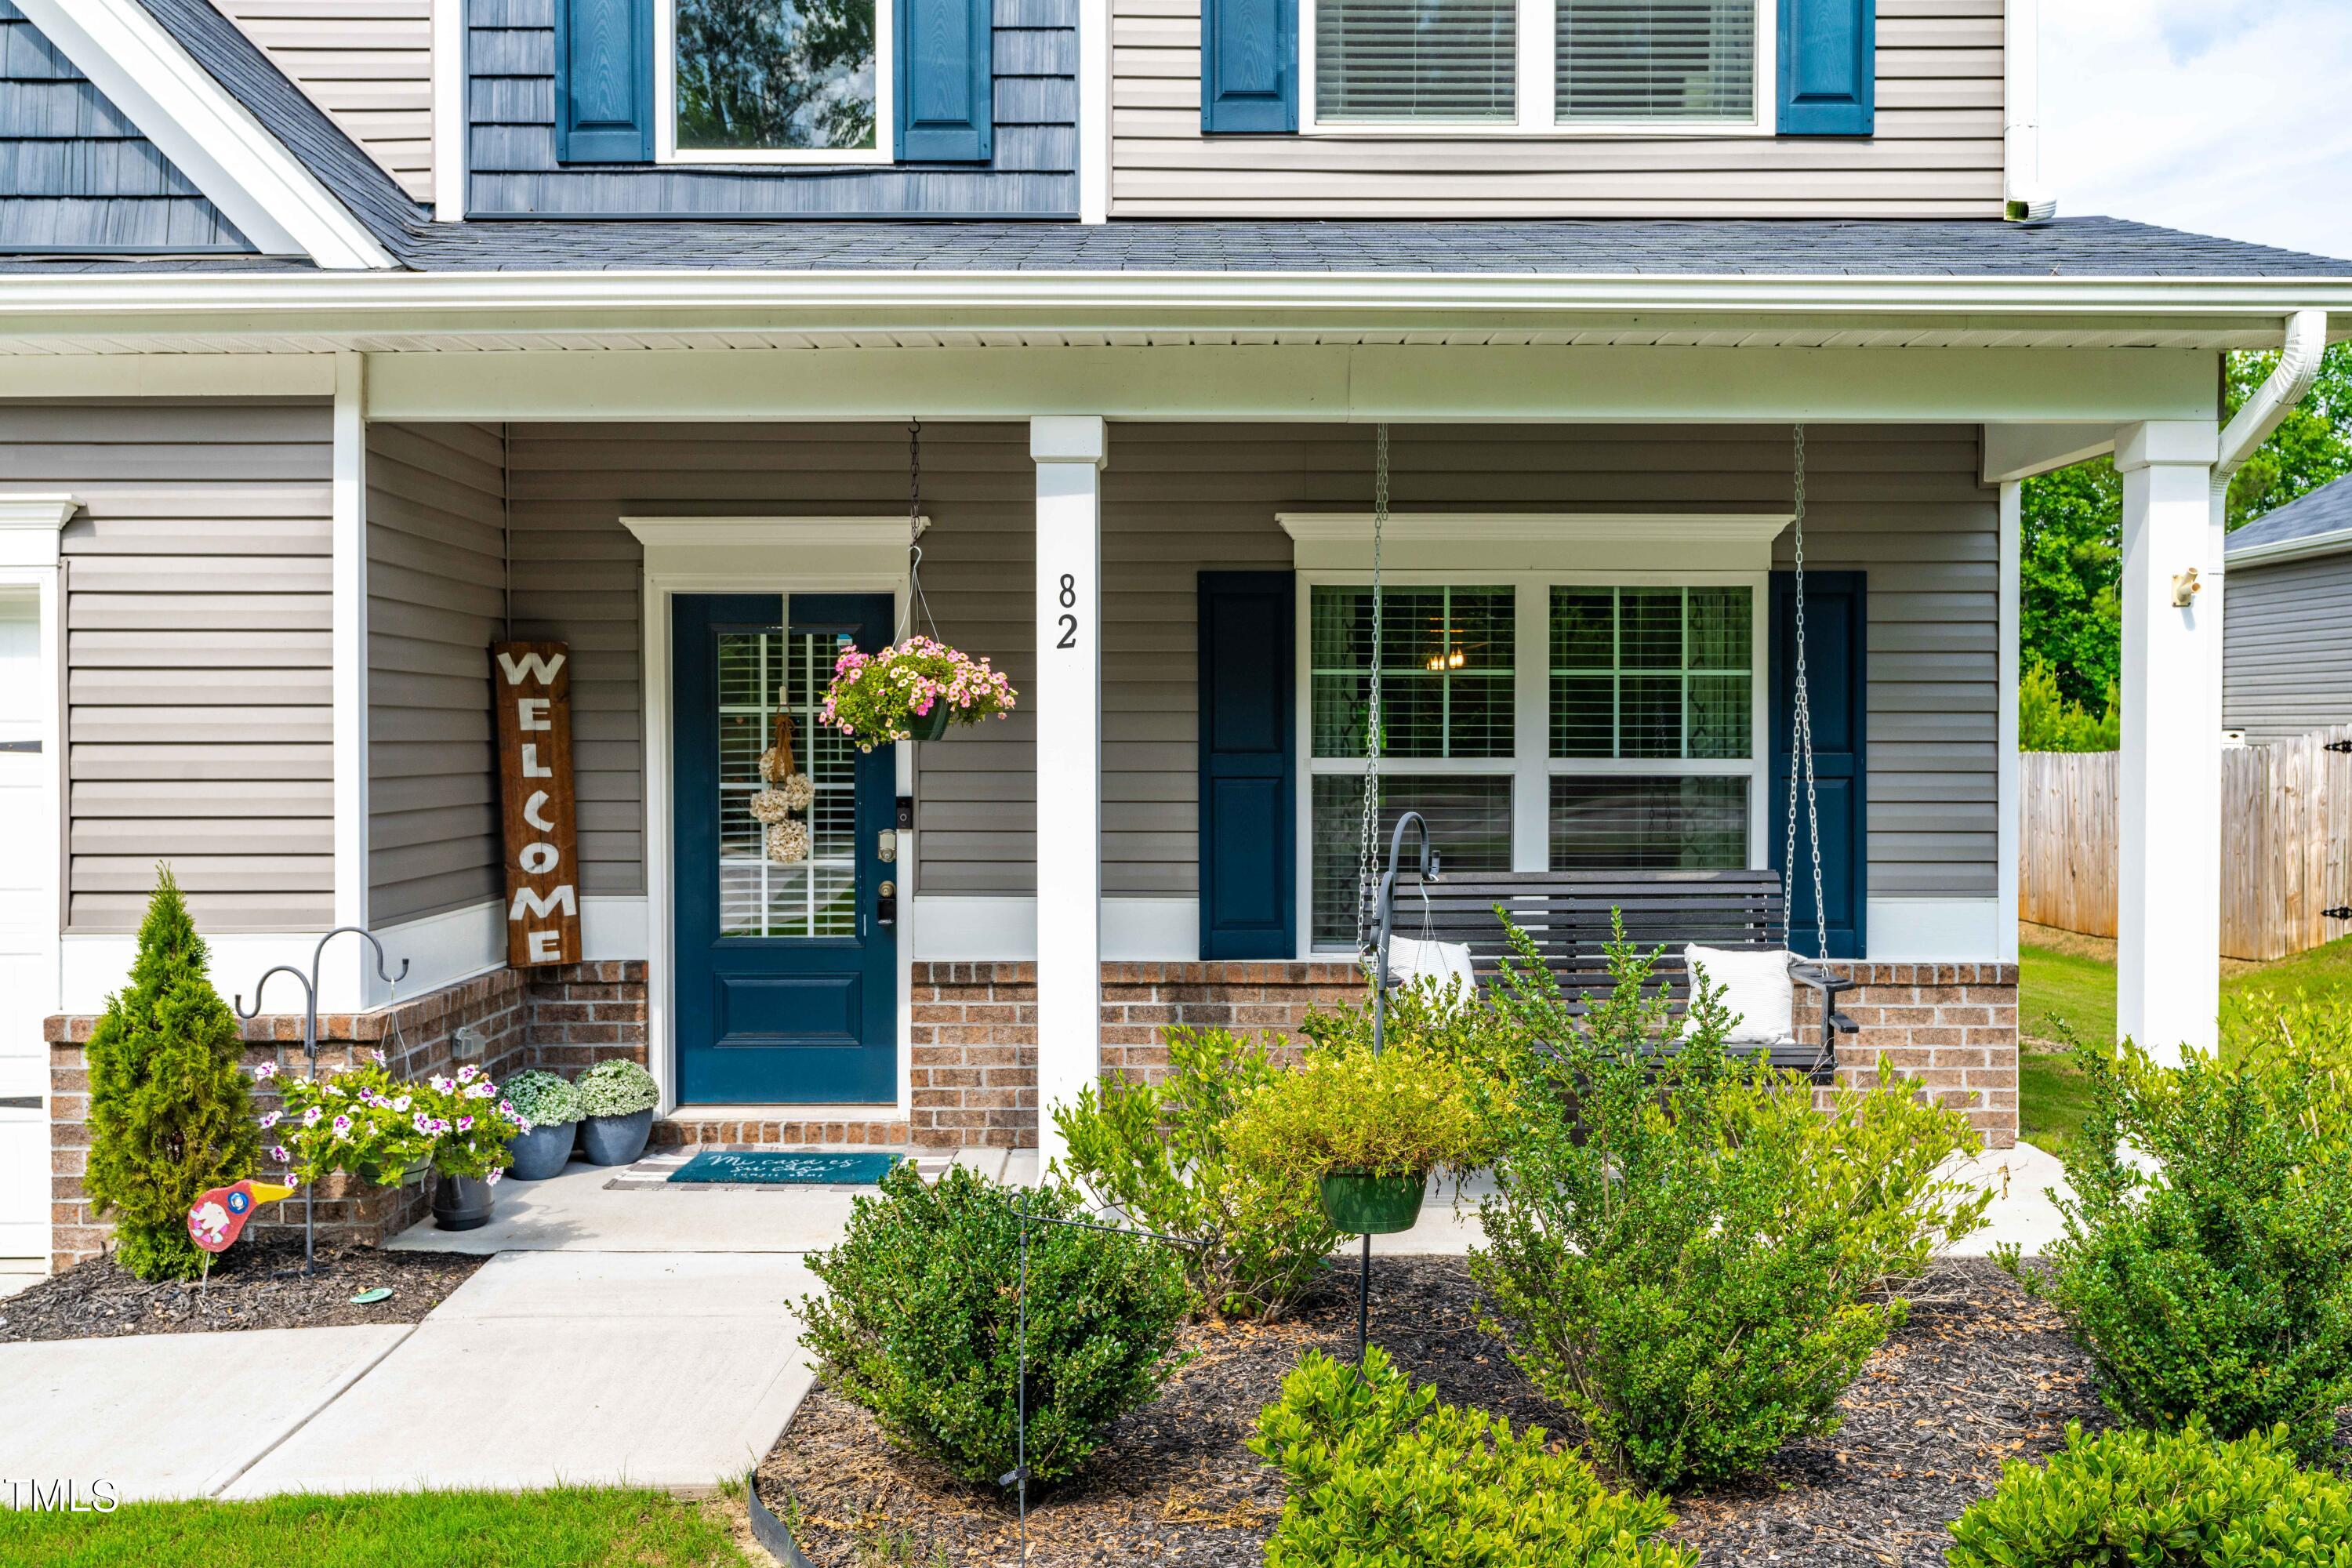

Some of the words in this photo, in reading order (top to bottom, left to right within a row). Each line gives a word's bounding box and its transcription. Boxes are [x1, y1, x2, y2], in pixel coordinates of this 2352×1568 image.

[1056, 573, 1077, 649] 82
[497, 652, 577, 963] WELCOME
[761, 1158, 823, 1167] casa
[829, 1158, 862, 1168] es
[771, 1165, 834, 1174] casa
